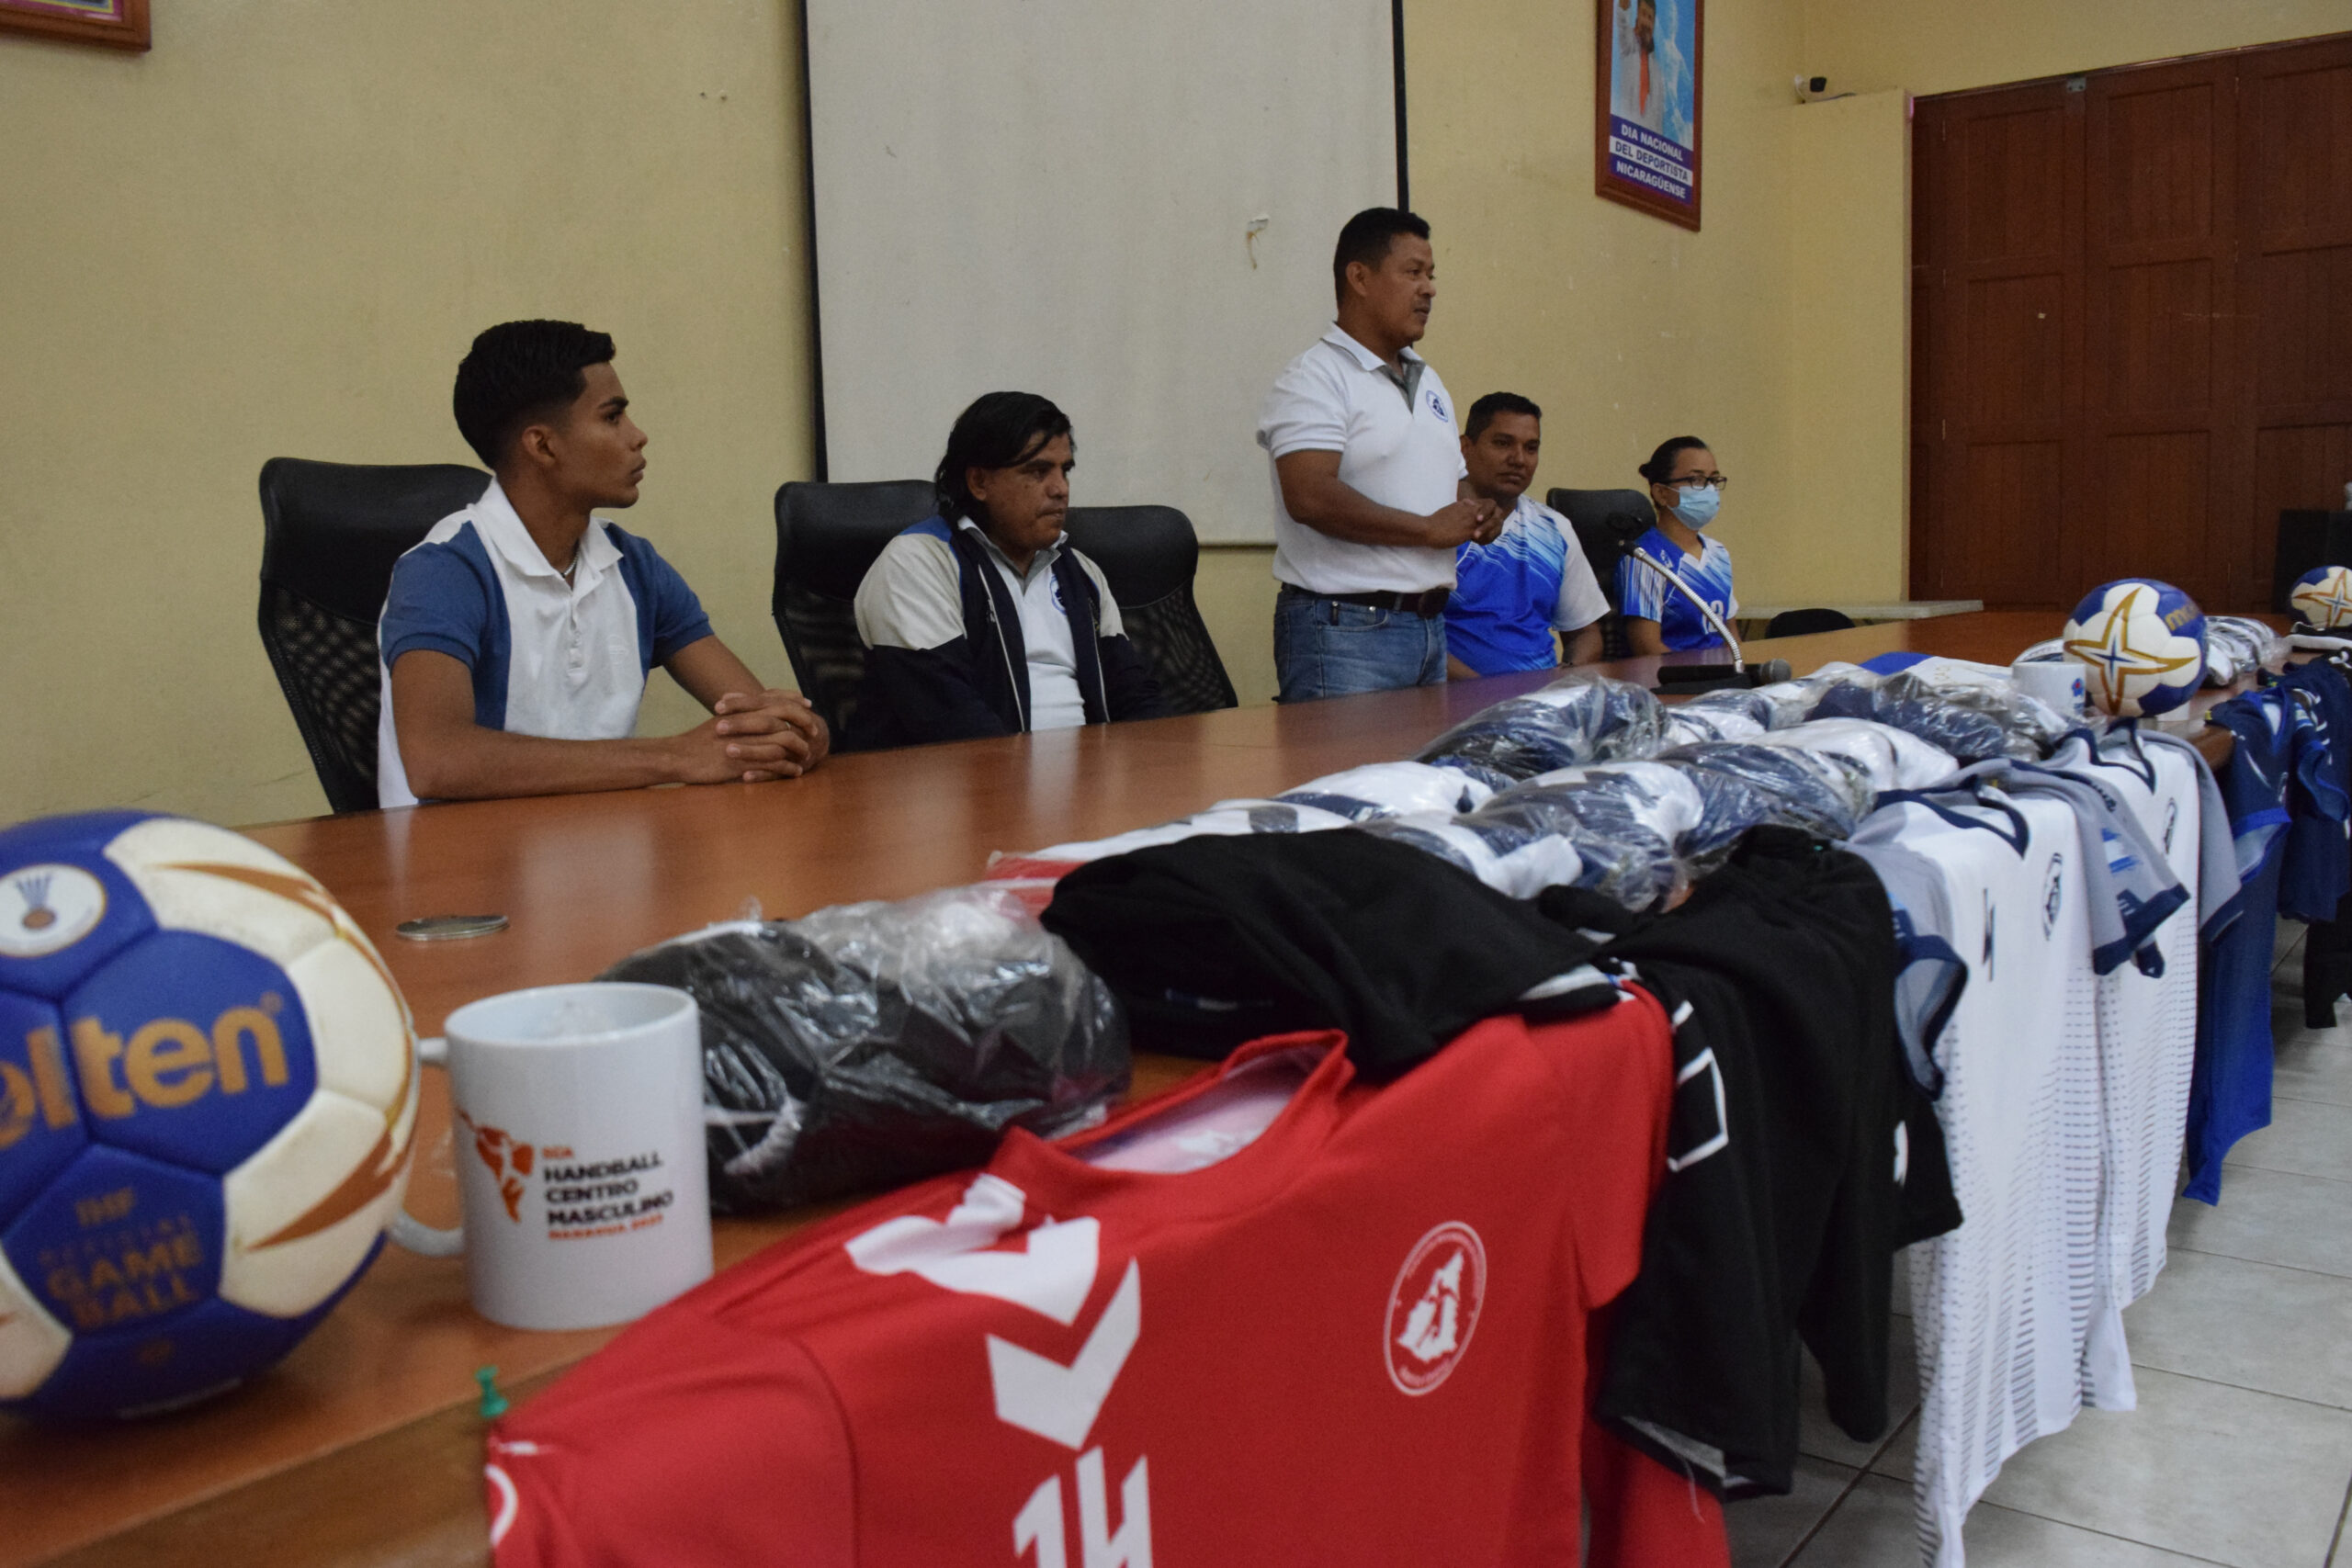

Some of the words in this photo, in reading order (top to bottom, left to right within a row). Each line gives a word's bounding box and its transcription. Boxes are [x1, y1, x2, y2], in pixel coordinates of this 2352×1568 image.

[1621, 124, 1638, 141] DIA
[1640, 131, 1683, 162] NACIONAL
[1615, 141, 1634, 158] DEL
[1636, 150, 1689, 182] DEPORTISTA
[1616, 161, 1686, 198] NICARAGÜENSE
[544, 1152, 662, 1182] HANDBALL
[546, 1179, 639, 1203] CENTRO
[548, 1189, 673, 1225] MASCULINO
